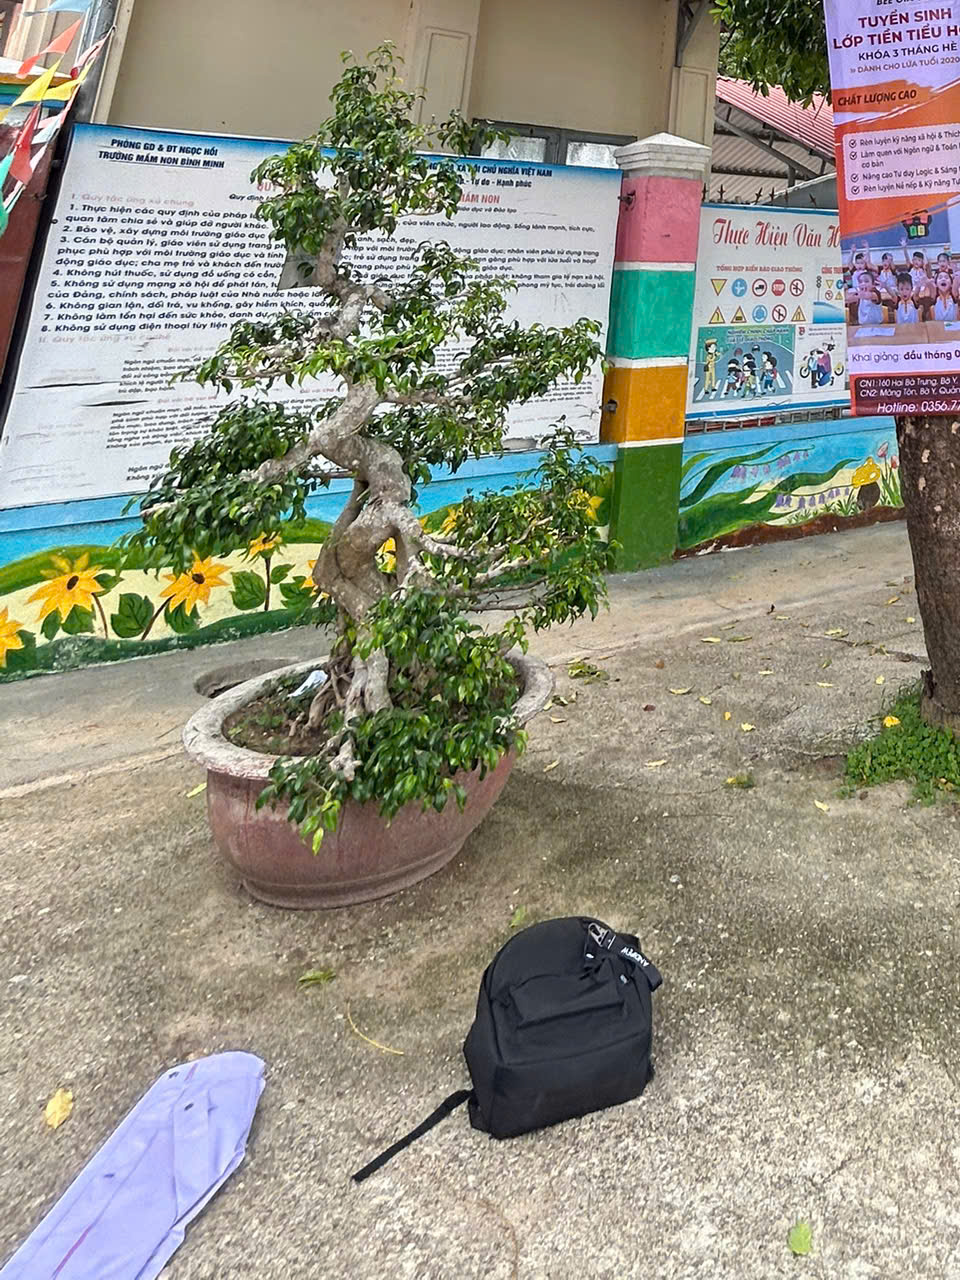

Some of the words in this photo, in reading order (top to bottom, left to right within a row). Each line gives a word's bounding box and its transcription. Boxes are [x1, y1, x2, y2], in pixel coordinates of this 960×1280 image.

[858, 9, 909, 29] TUYỂN
[914, 8, 952, 22] SINH
[833, 34, 863, 49] LỚP
[868, 29, 903, 46] TIỀN
[906, 24, 942, 41] TIỂU
[858, 49, 891, 61] KHÓA
[893, 49, 899, 57] 3
[901, 43, 939, 56] THÁNG
[943, 41, 958, 52] HÈ
[858, 64, 881, 73] DÀNH
[883, 63, 901, 71] CHO
[902, 60, 918, 69] LỨA
[919, 56, 938, 66] TUỔI
[838, 94, 861, 106] CHẤT
[864, 91, 896, 104] LƯỢNG
[898, 90, 917, 101] CAO
[111, 139, 141, 150] PHÒNG
[144, 143, 155, 151] GD
[166, 145, 177, 153] ĐT
[179, 146, 201, 155] NGỌC
[99, 150, 133, 161] TRƯỜNG
[160, 157, 178, 165] NON
[181, 156, 201, 166] BÌNH
[203, 160, 224, 168] MINH
[481, 195, 500, 204] NON
[70, 204, 78, 212] 1.
[82, 204, 106, 213] Thực
[110, 205, 132, 215] hiện
[135, 207, 154, 215] các
[158, 209, 176, 217] quy
[179, 208, 200, 218] định
[202, 210, 220, 218] của
[223, 212, 247, 220] pháp
[66, 215, 93, 223] quan
[97, 215, 118, 223] tâm
[121, 216, 144, 224] chia
[161, 218, 173, 226] và
[176, 219, 198, 228] giúp
[216, 221, 242, 230] người
[244, 221, 269, 229] khác.
[76, 225, 97, 234] Bảo
[101, 227, 116, 235] vệ,
[120, 228, 138, 236] xây
[142, 229, 168, 237] dựng
[192, 231, 222, 239] trường
[713, 218, 749, 250] Thực
[755, 221, 789, 251] Hiện
[793, 223, 822, 248] Văn
[55, 324, 91, 332] Không
[94, 323, 106, 331] sử
[109, 324, 136, 332] dụng
[139, 322, 162, 331] điện
[164, 322, 190, 331] thoại
[193, 322, 208, 330] tùy
[210, 322, 228, 330] tiện
[852, 353, 872, 362] Khai
[904, 350, 922, 360] đầu
[925, 350, 952, 360] tháng
[879, 379, 890, 387] 160
[892, 379, 903, 387] Hai
[877, 402, 919, 413] Hotline:
